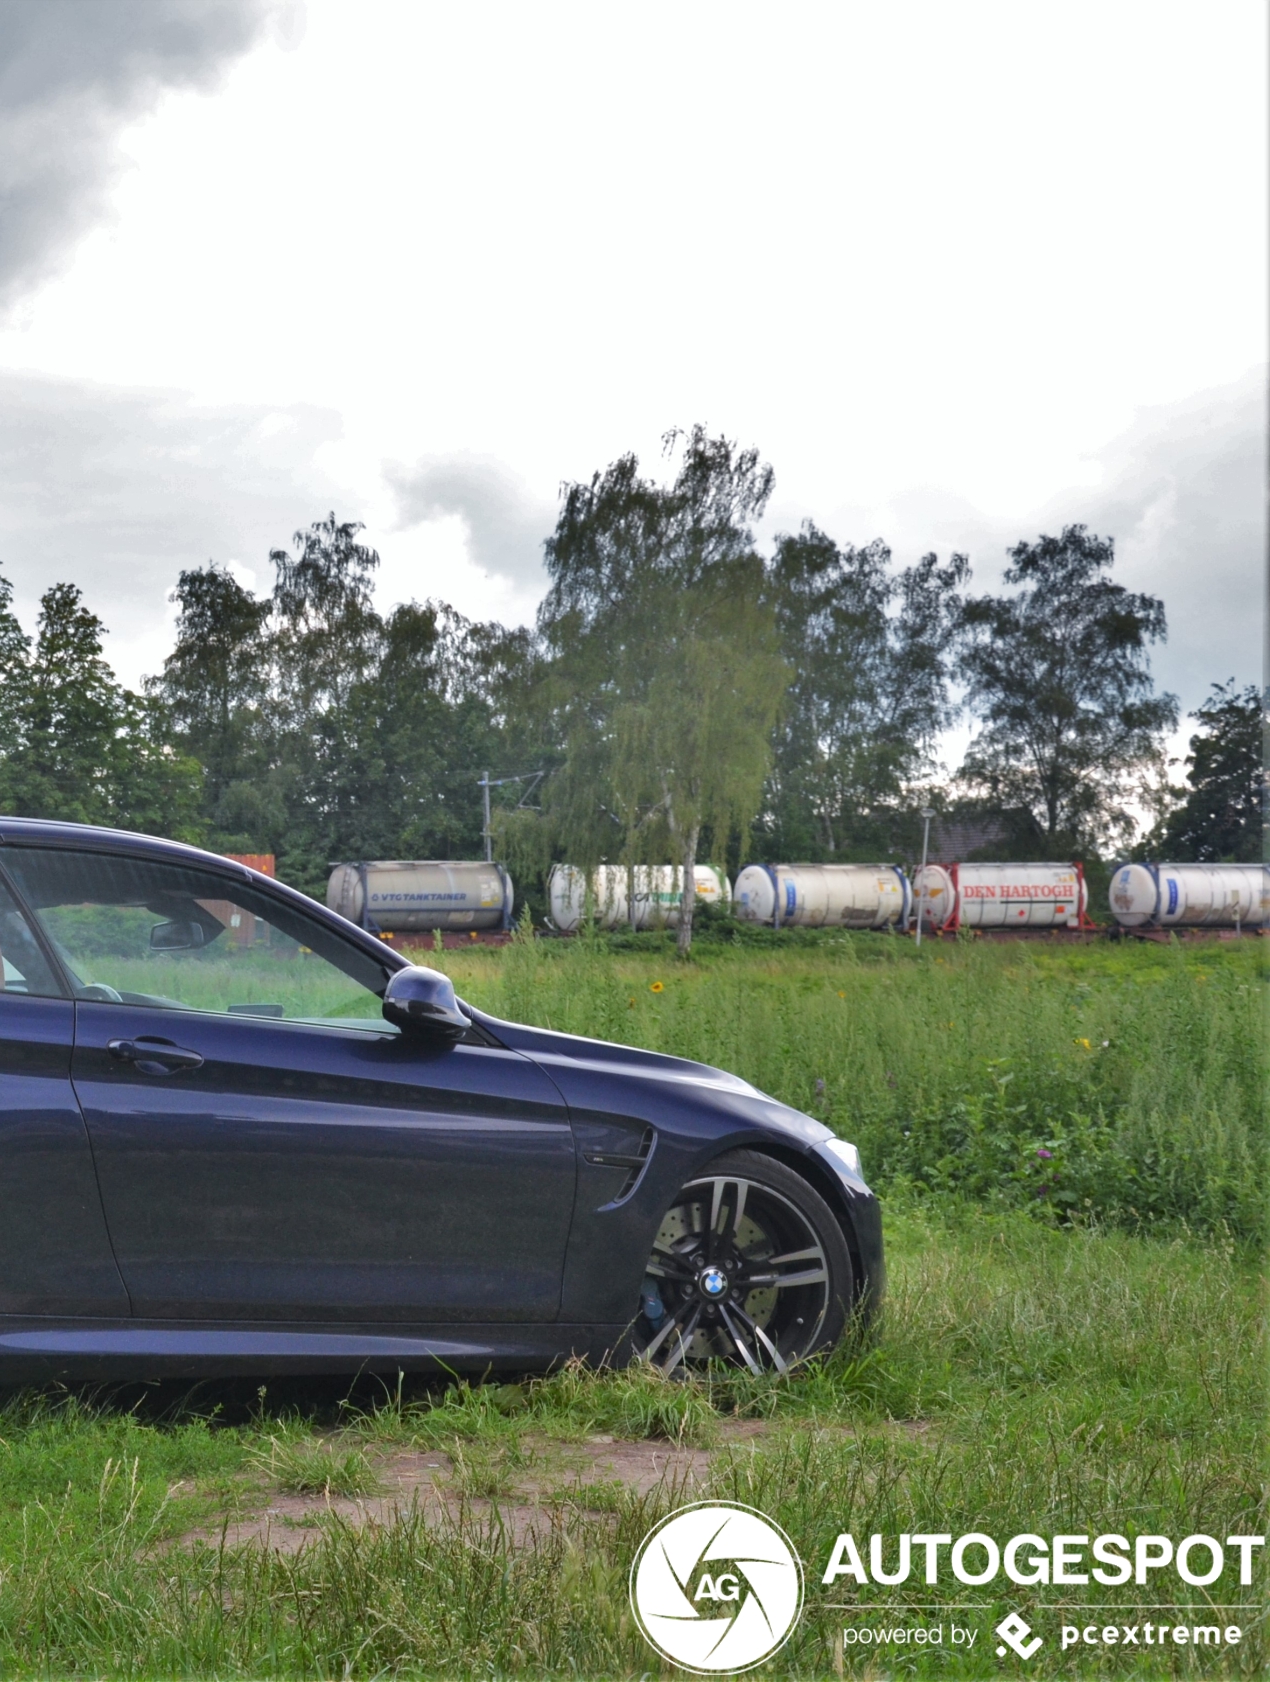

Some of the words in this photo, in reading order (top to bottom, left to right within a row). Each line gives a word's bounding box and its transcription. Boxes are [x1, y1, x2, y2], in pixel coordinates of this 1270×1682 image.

[963, 885, 996, 898] DEN
[999, 885, 1074, 898] HARTOGH
[381, 893, 403, 901] VTG
[403, 893, 467, 901] TANKTAINER
